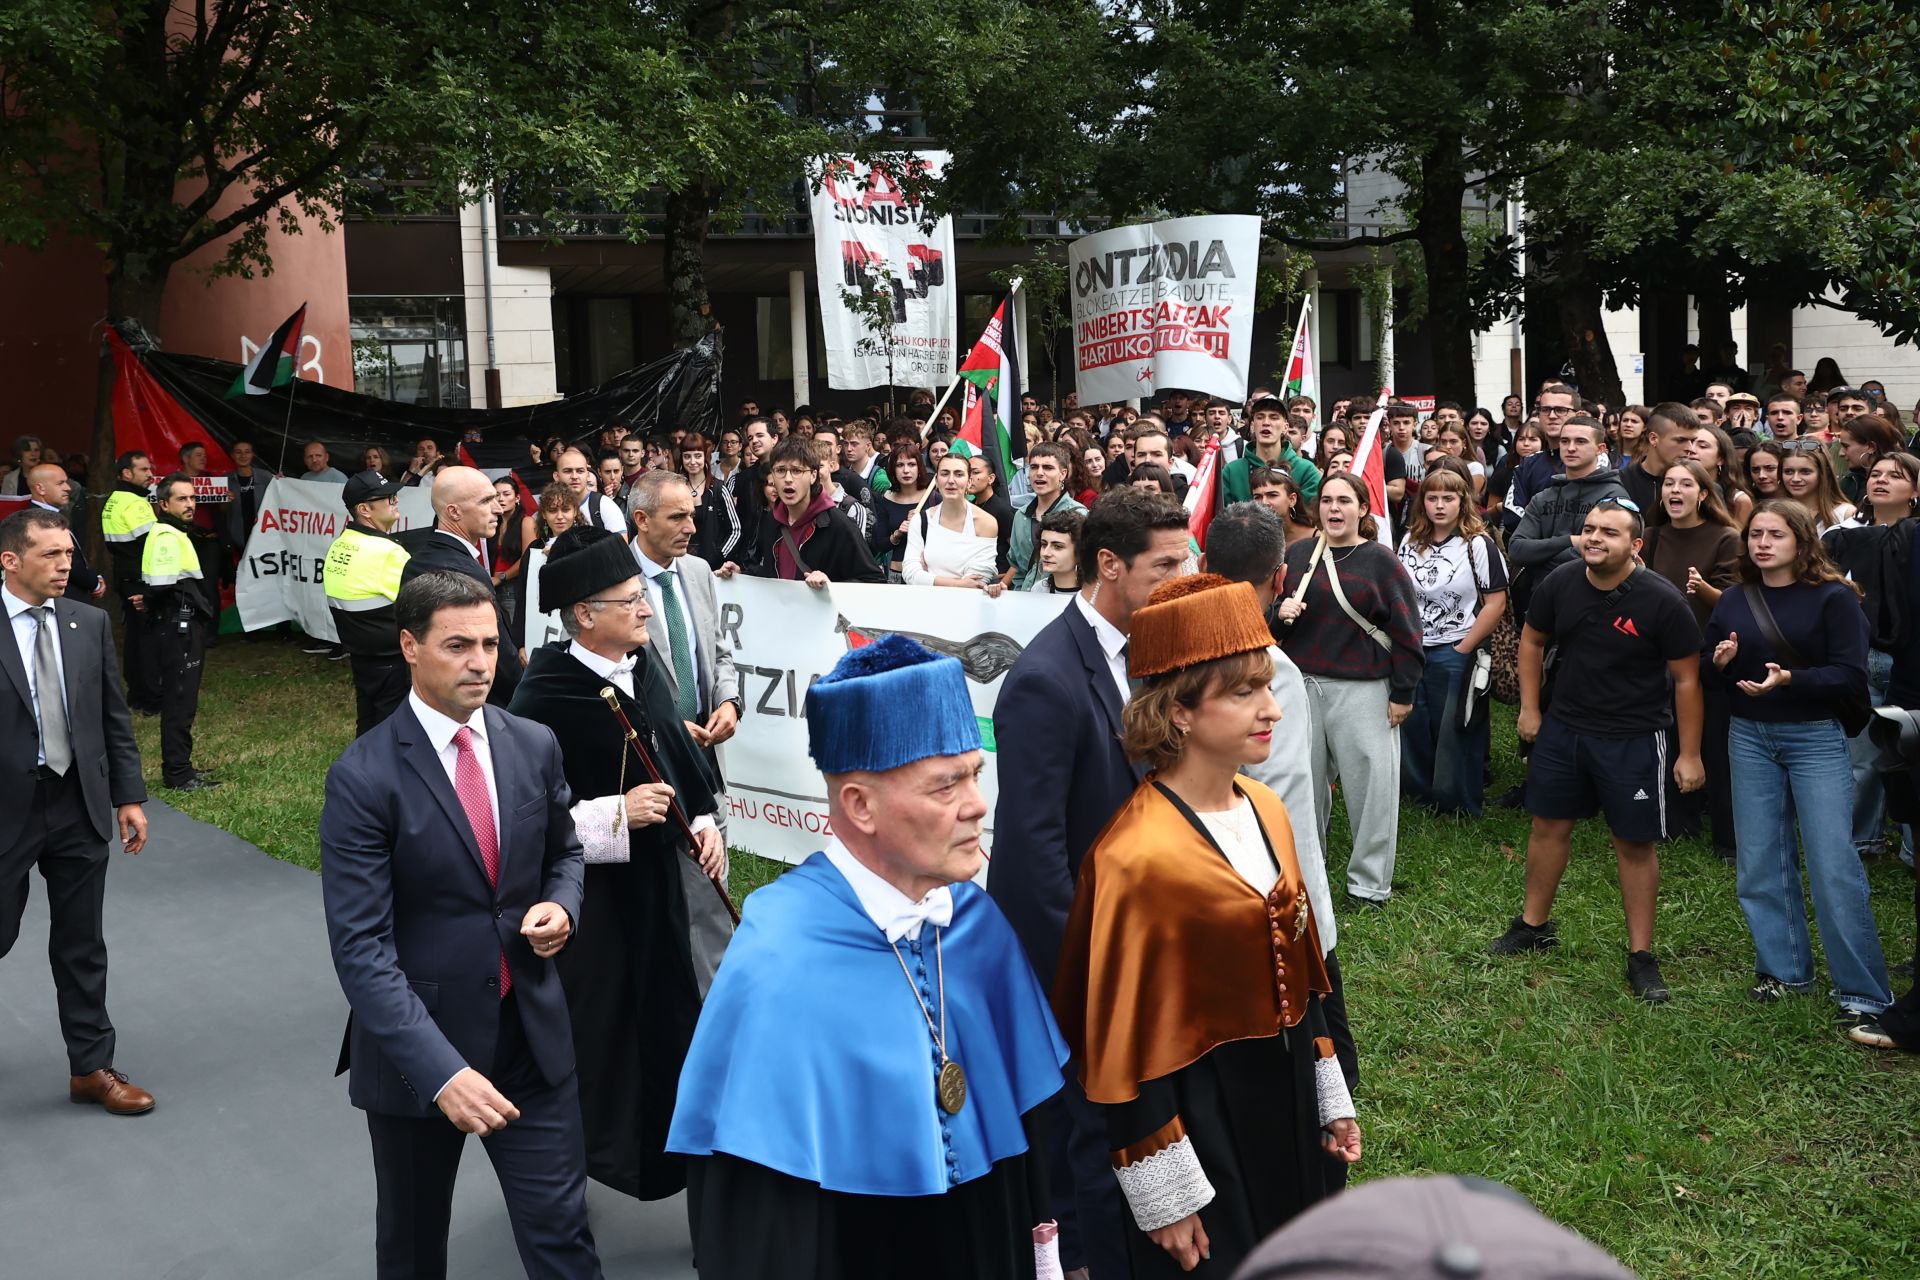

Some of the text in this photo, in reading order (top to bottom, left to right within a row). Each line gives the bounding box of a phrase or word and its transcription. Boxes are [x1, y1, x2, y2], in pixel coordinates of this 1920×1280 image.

[1076, 240, 1236, 297] ONTZDIA
[1080, 335, 1154, 368] HARTUKO
[763, 803, 833, 836] GENOZ
